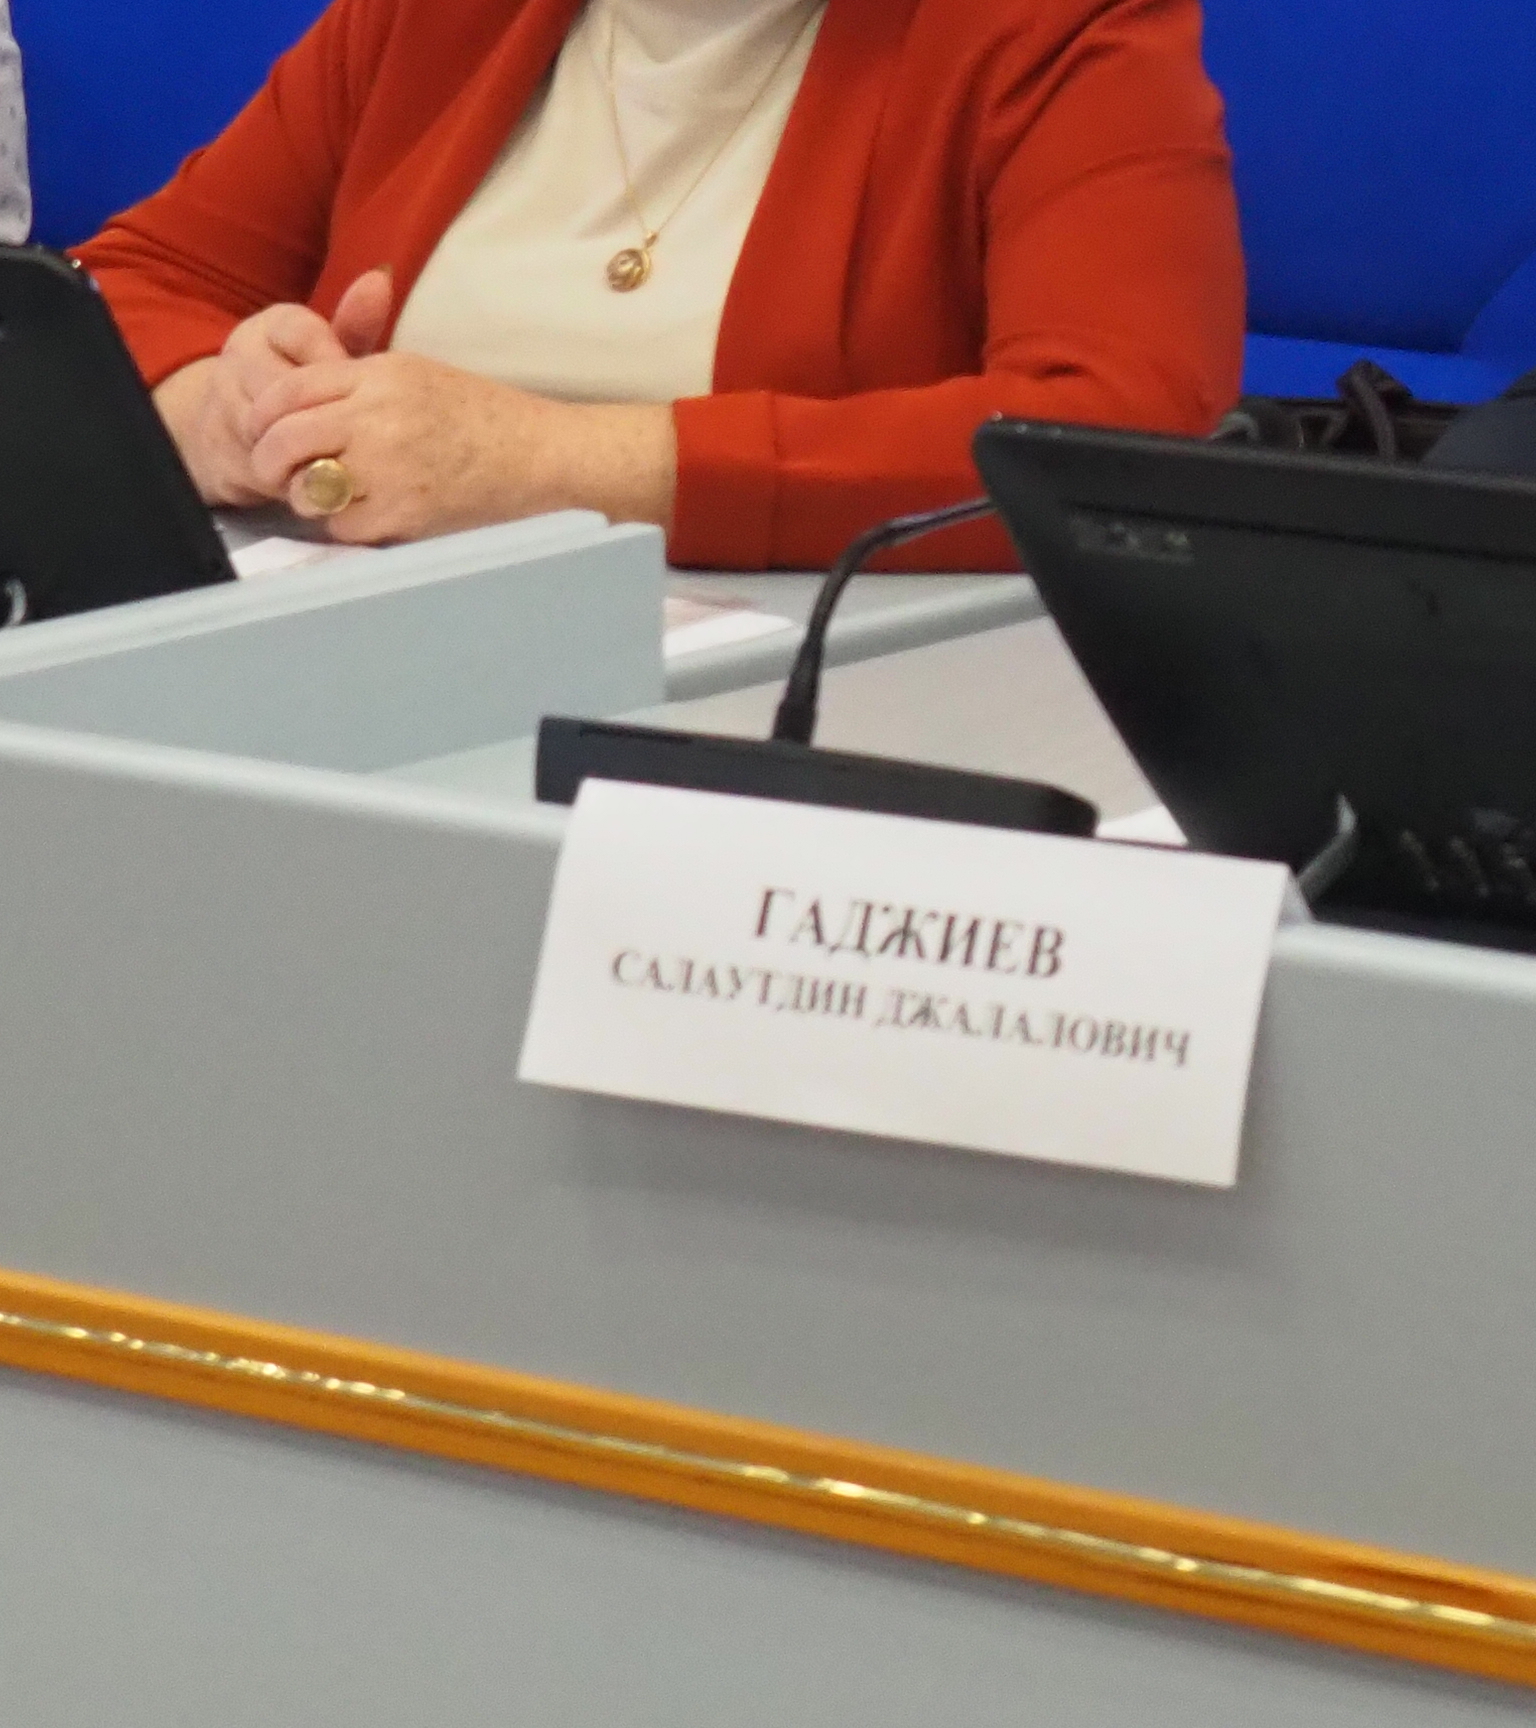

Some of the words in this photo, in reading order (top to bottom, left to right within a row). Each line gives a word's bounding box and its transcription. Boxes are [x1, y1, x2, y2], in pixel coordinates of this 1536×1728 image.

[752, 887, 1065, 979] ГАДЖИЕВ
[612, 951, 867, 1020] САЛАУТДИН
[875, 987, 1191, 1067] ДЖАЛАЛОВИЧ
